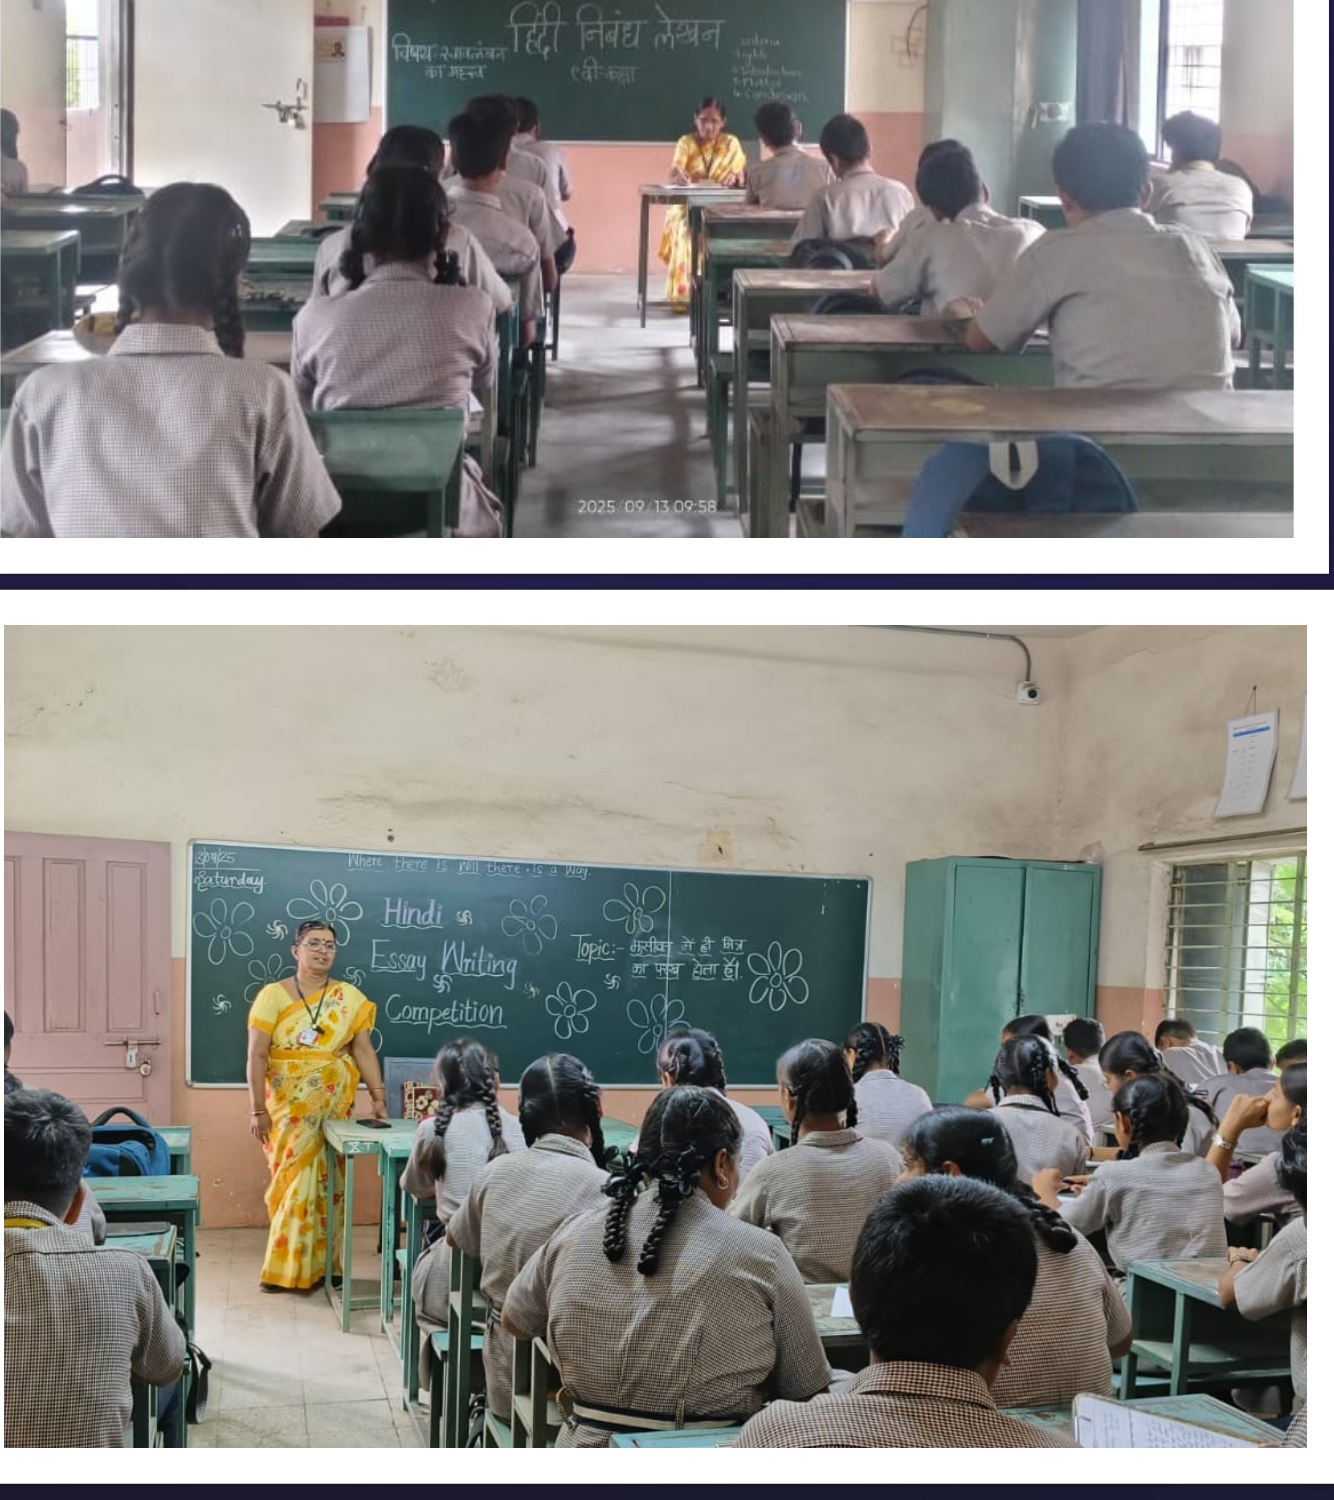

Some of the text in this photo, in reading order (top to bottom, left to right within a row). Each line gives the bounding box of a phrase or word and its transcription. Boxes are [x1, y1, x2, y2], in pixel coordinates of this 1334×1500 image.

[575, 3, 648, 50] निबंध
[653, 2, 726, 50] लेखन
[347, 853, 383, 869] Where
[395, 858, 428, 871] there
[194, 871, 265, 894] Saturday
[382, 898, 444, 927] Hindi
[372, 938, 517, 989] Essay Writing
[386, 994, 503, 1037] Competition
